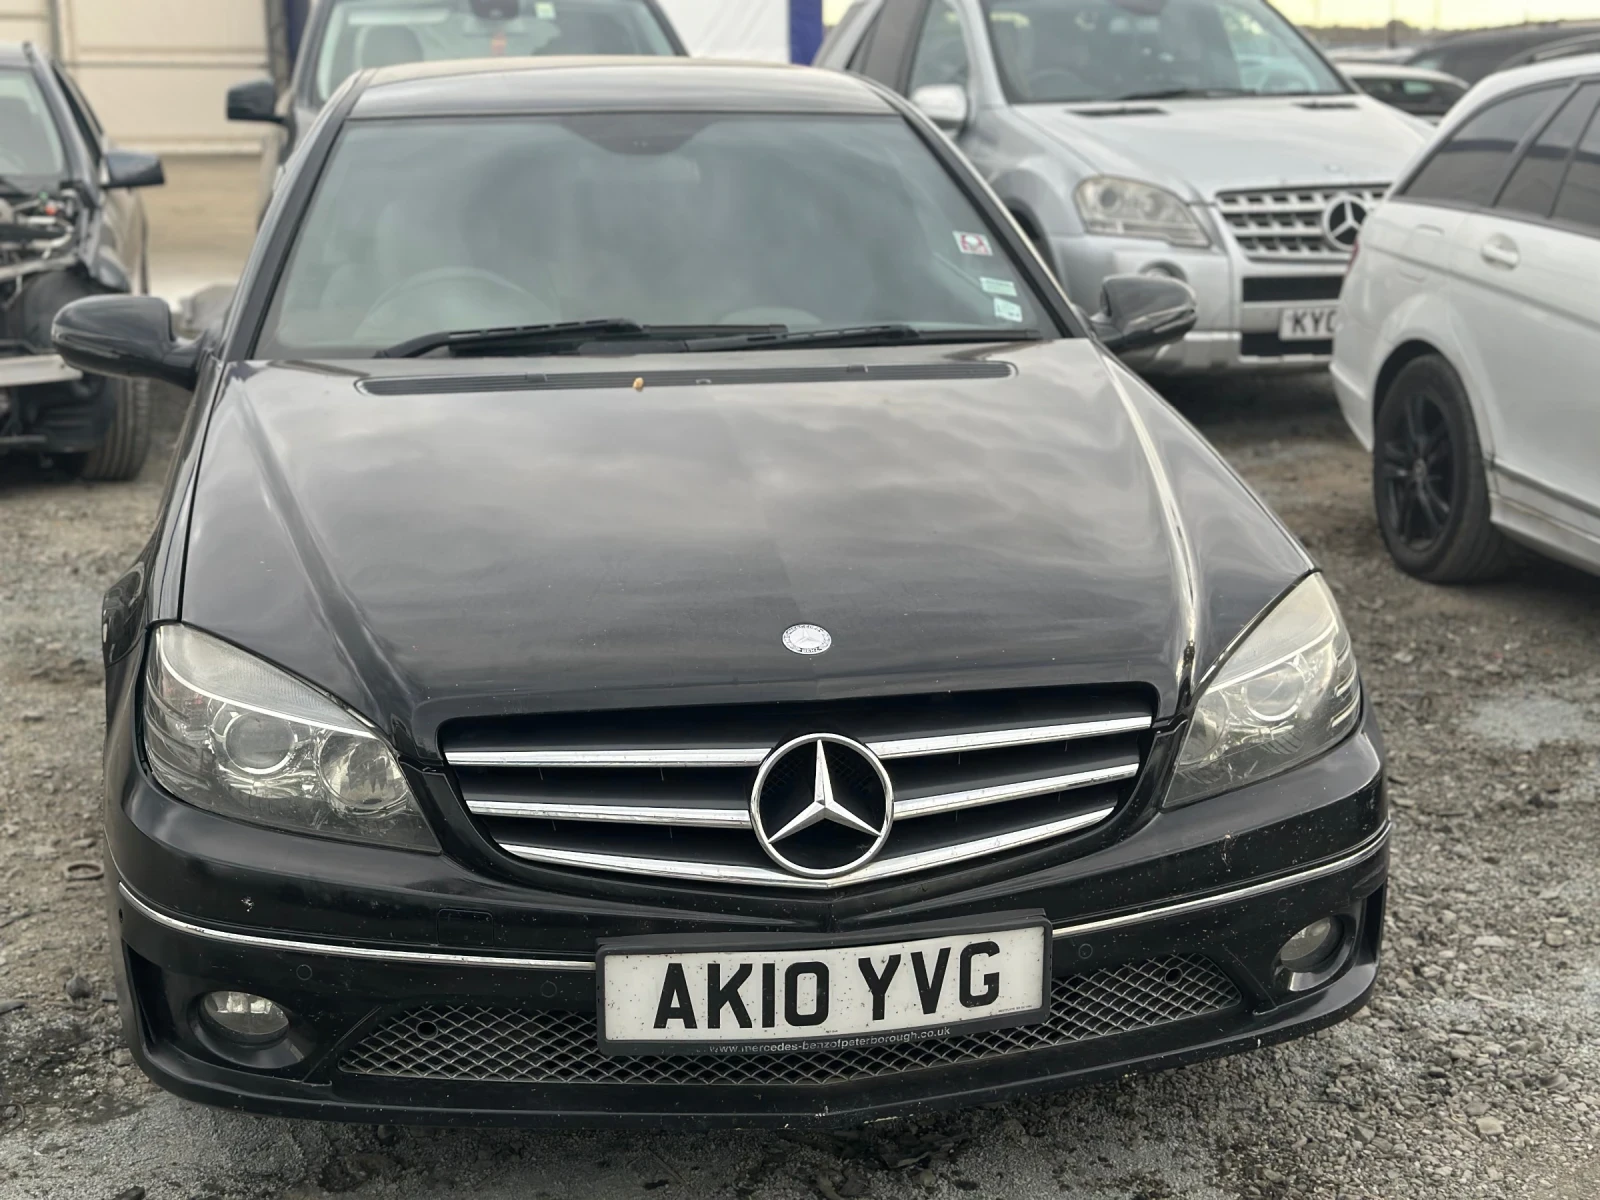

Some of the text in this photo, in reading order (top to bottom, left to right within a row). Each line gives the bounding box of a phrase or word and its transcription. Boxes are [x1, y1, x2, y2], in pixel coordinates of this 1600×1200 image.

[653, 940, 1000, 1030] AK10 YVG
[709, 1026, 951, 1053] www.mercedes-benzofpeterborough.co.uk
